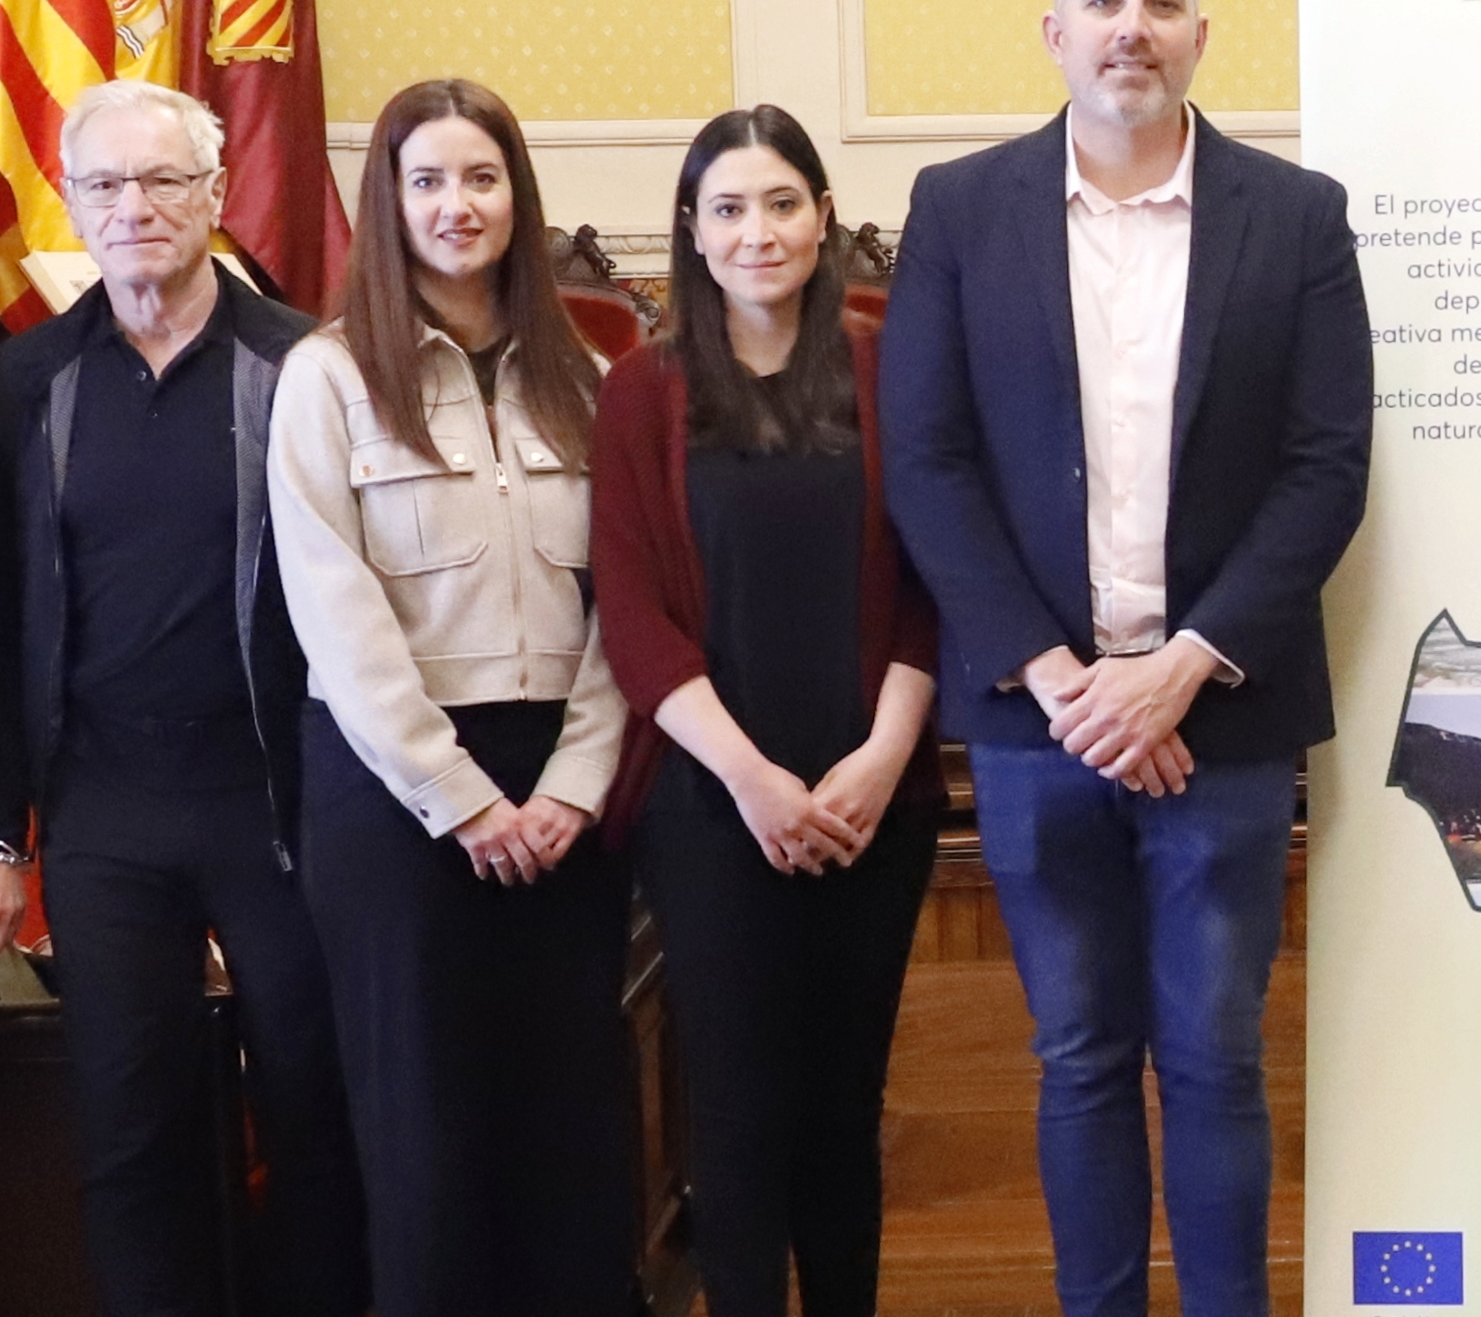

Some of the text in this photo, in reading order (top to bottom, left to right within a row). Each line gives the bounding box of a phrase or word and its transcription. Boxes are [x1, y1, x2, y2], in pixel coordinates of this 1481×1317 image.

[1374, 194, 1395, 215] El
[1354, 225, 1462, 253] pretende
[1369, 323, 1443, 344] eativa
